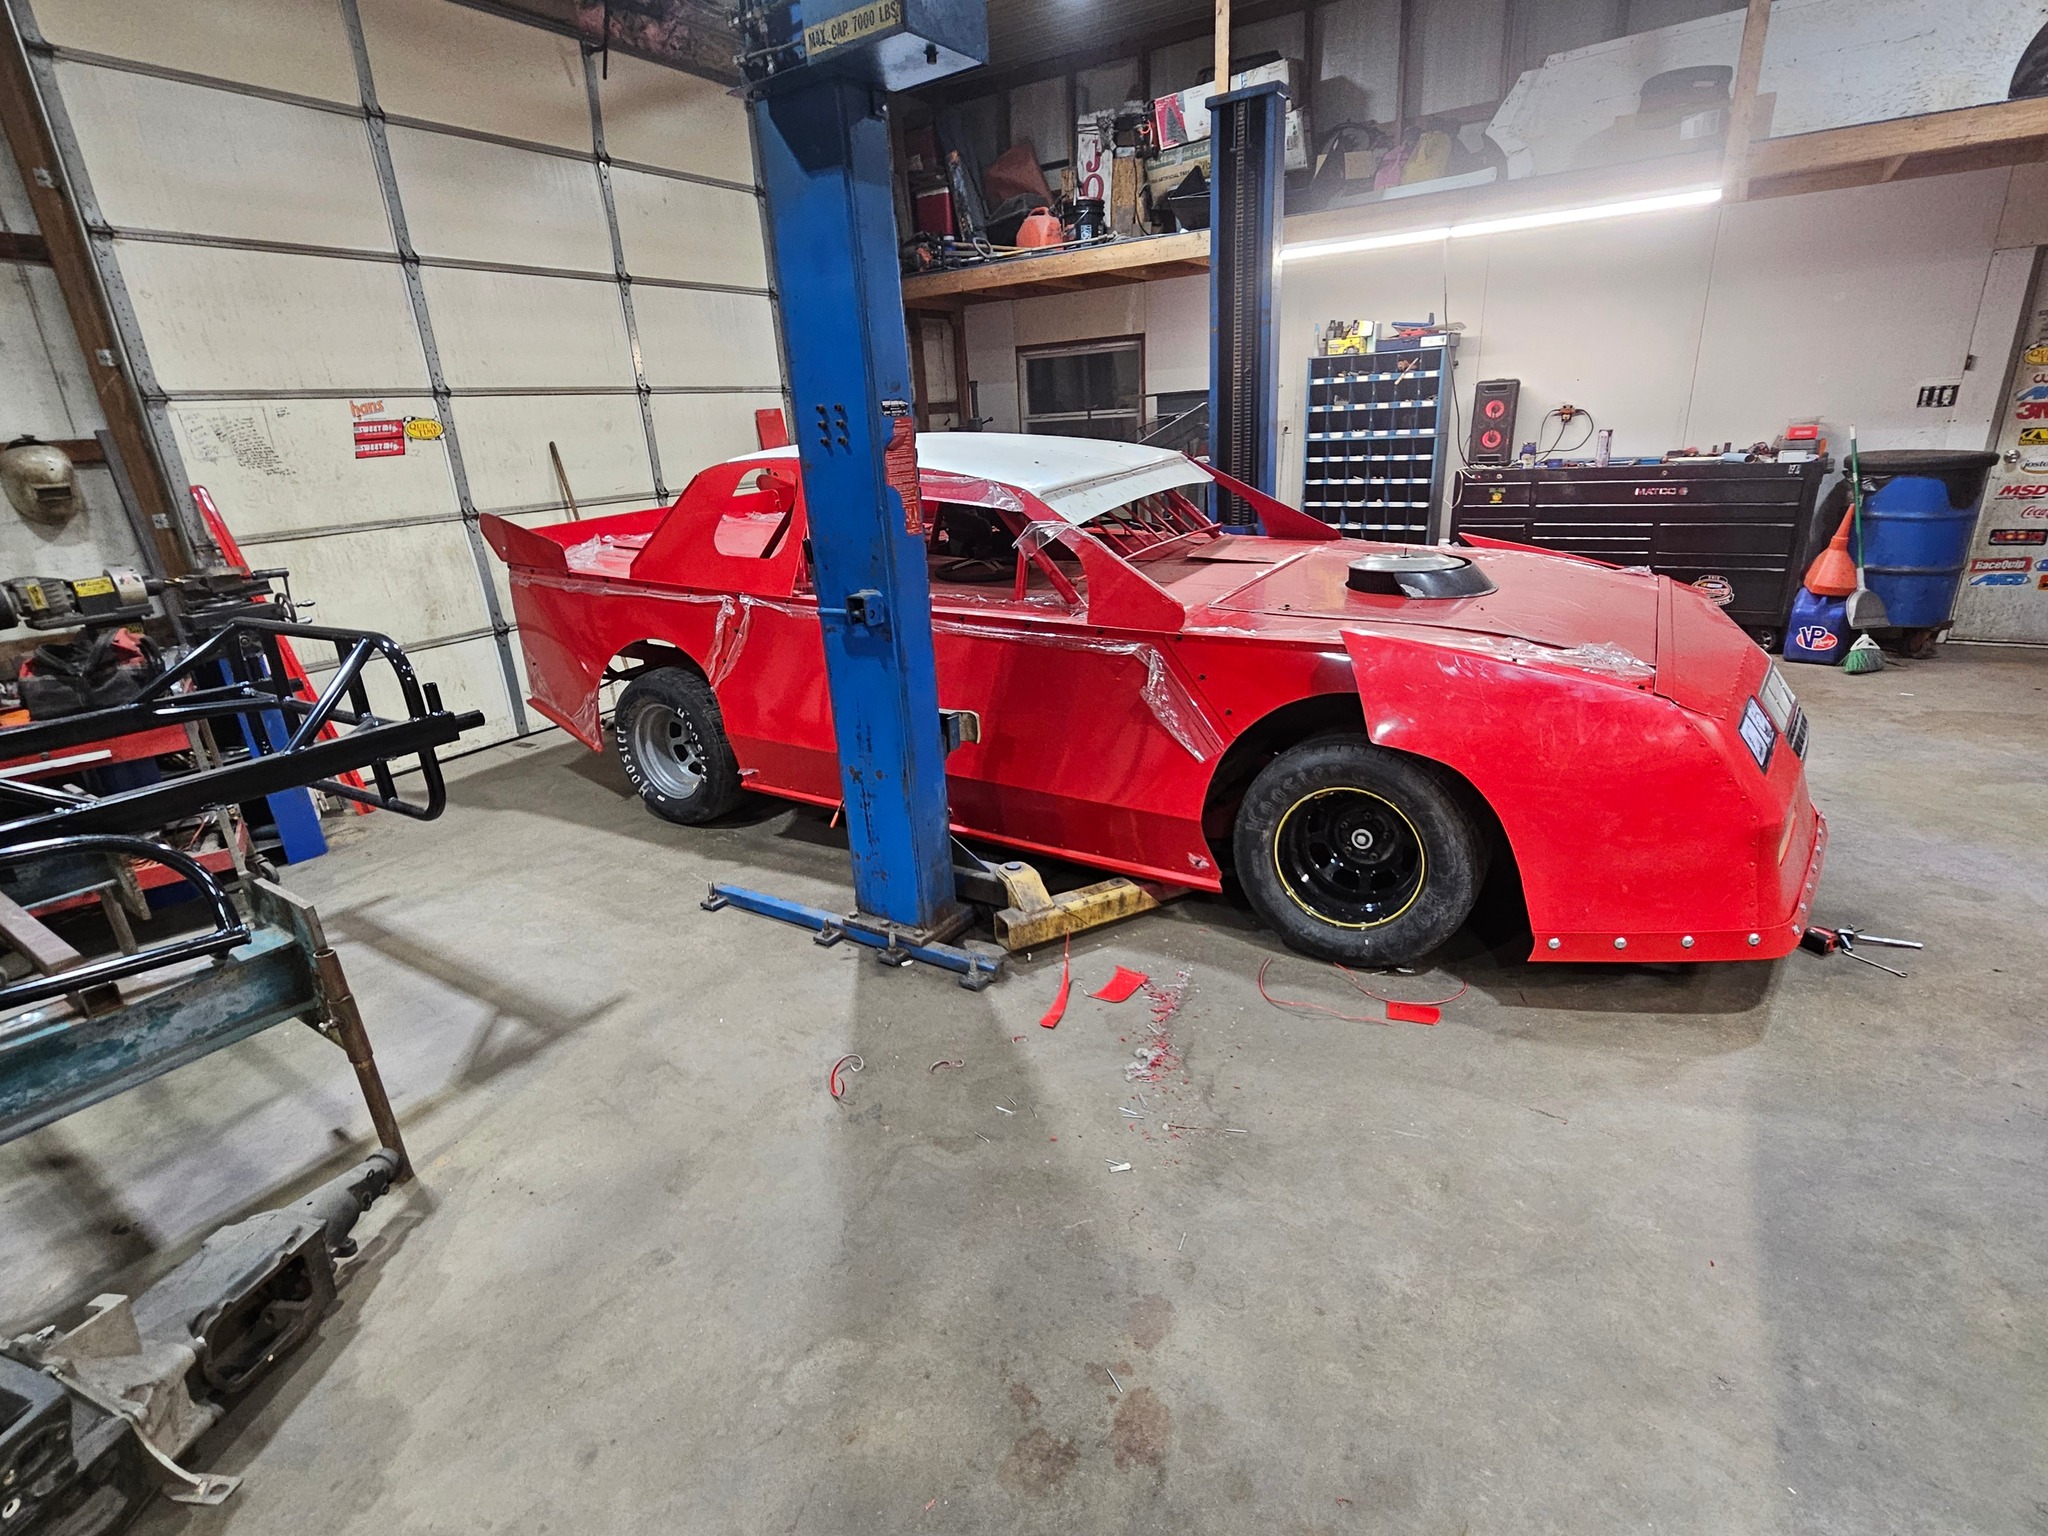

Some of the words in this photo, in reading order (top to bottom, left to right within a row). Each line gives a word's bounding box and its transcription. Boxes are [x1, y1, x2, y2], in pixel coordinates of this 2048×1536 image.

[831, 20, 850, 40] CAP.
[852, 9, 875, 32] 7000
[409, 422, 437, 431] QUICK
[1634, 487, 1677, 496] MATCO
[1998, 485, 2048, 496] MSD
[1975, 560, 2027, 570] RaceQuip
[1799, 626, 1827, 649] VP
